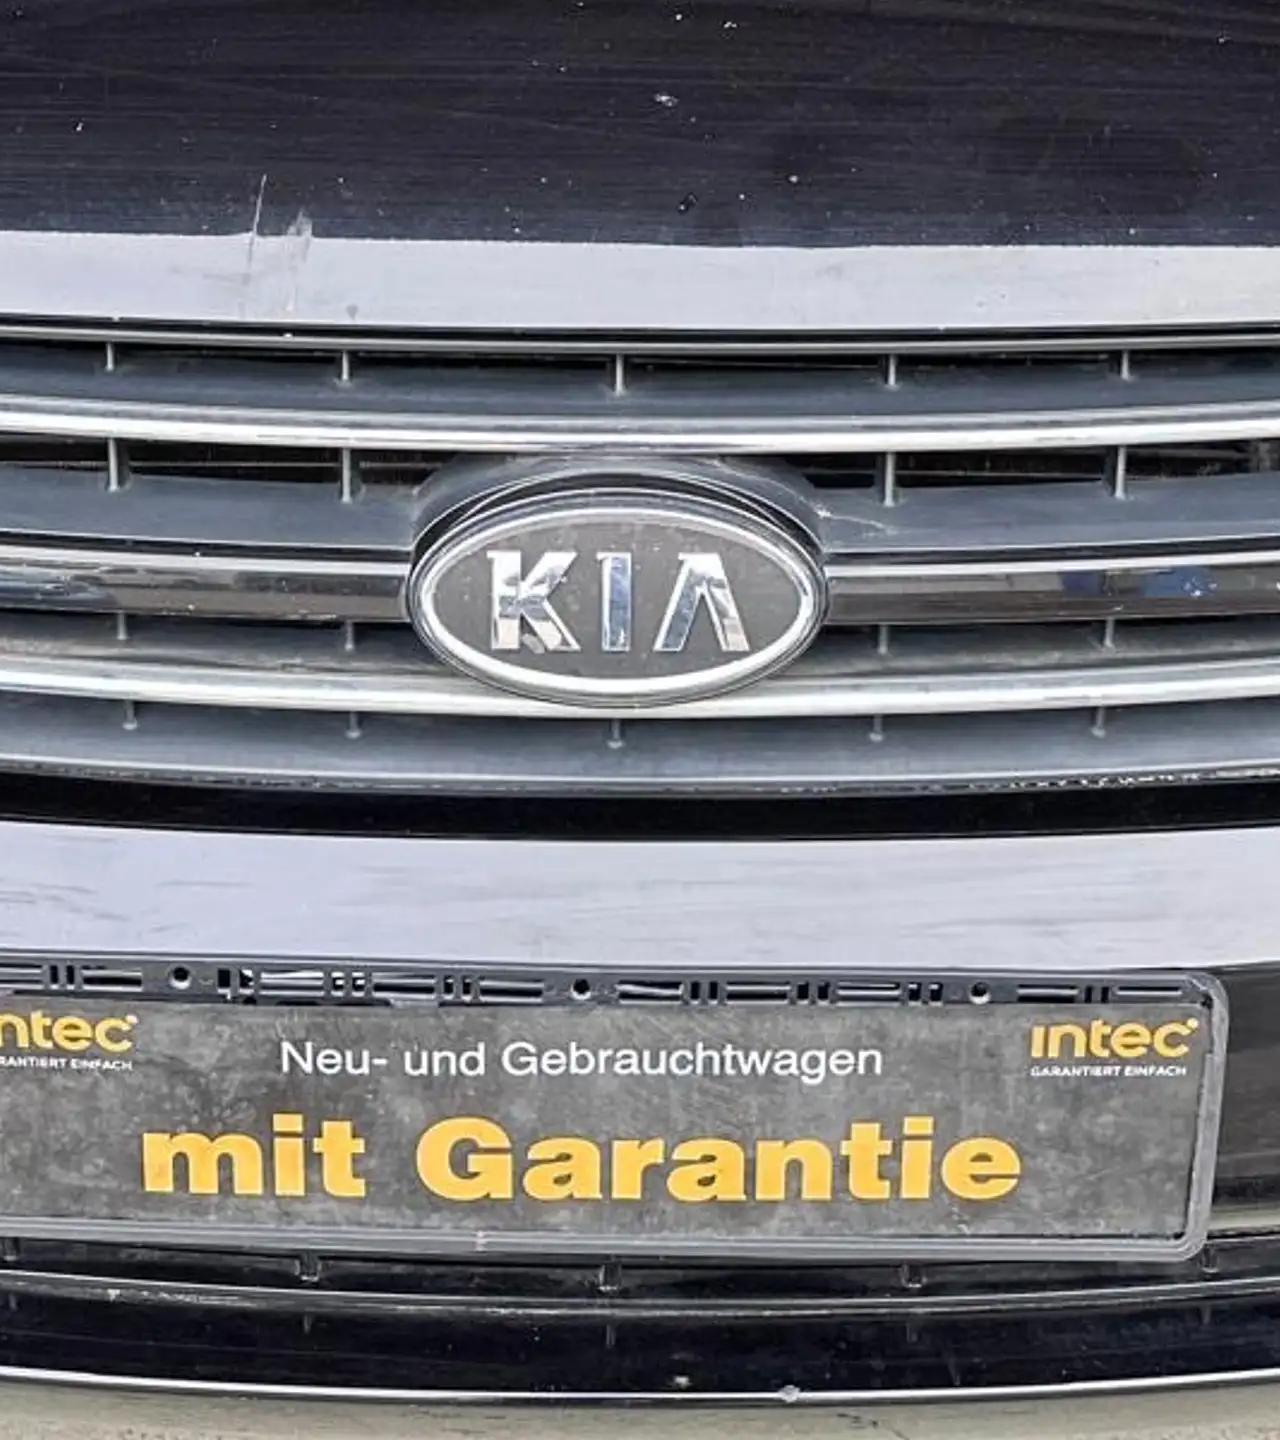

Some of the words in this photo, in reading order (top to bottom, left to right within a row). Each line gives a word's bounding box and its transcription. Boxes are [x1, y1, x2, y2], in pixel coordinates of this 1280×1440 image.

[487, 550, 751, 653] KIA
[1031, 1018, 1199, 1058] intec
[71, 1058, 133, 1071] EINFACH
[281, 1042, 388, 1076] Neu-
[404, 1043, 486, 1076] und
[501, 1043, 882, 1085] Gebrauchtwagen
[1031, 1065, 1120, 1077] GARANTIERT
[1124, 1065, 1187, 1077] EINFACH
[142, 1112, 366, 1198] mit
[415, 1116, 1021, 1202] Garantie
